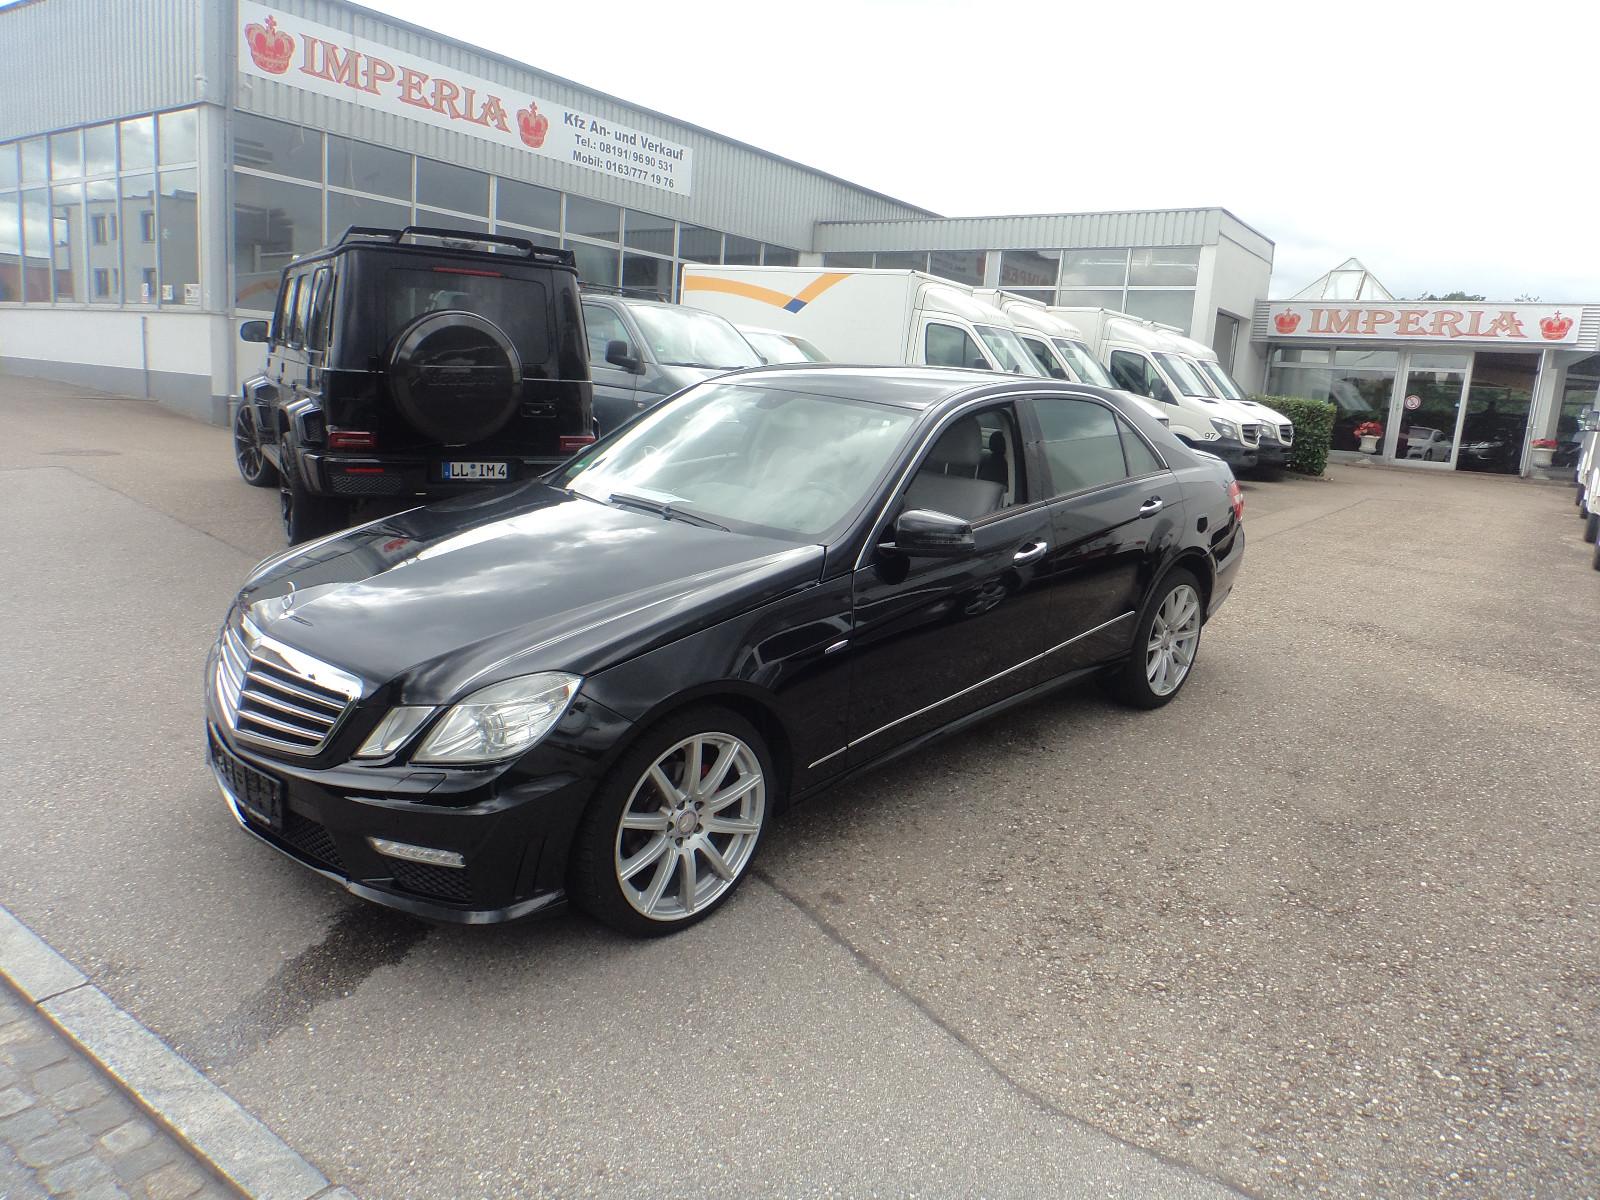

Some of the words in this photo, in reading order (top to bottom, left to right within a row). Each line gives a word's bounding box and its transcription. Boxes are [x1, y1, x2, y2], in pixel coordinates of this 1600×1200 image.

[299, 33, 512, 133] IMPERIA
[564, 112, 586, 130] Kfz
[590, 120, 611, 137] An-
[614, 130, 637, 146] und
[640, 135, 684, 161] Verkauf
[575, 134, 596, 150] Tel.:
[658, 159, 673, 173] 531
[572, 150, 603, 169] Mobil:
[606, 160, 648, 181] 0163/777
[651, 173, 661, 185] 19
[664, 176, 674, 189] 76
[1307, 308, 1528, 338] IMPERIA
[1204, 432, 1216, 440] 97
[451, 463, 469, 477] LL
